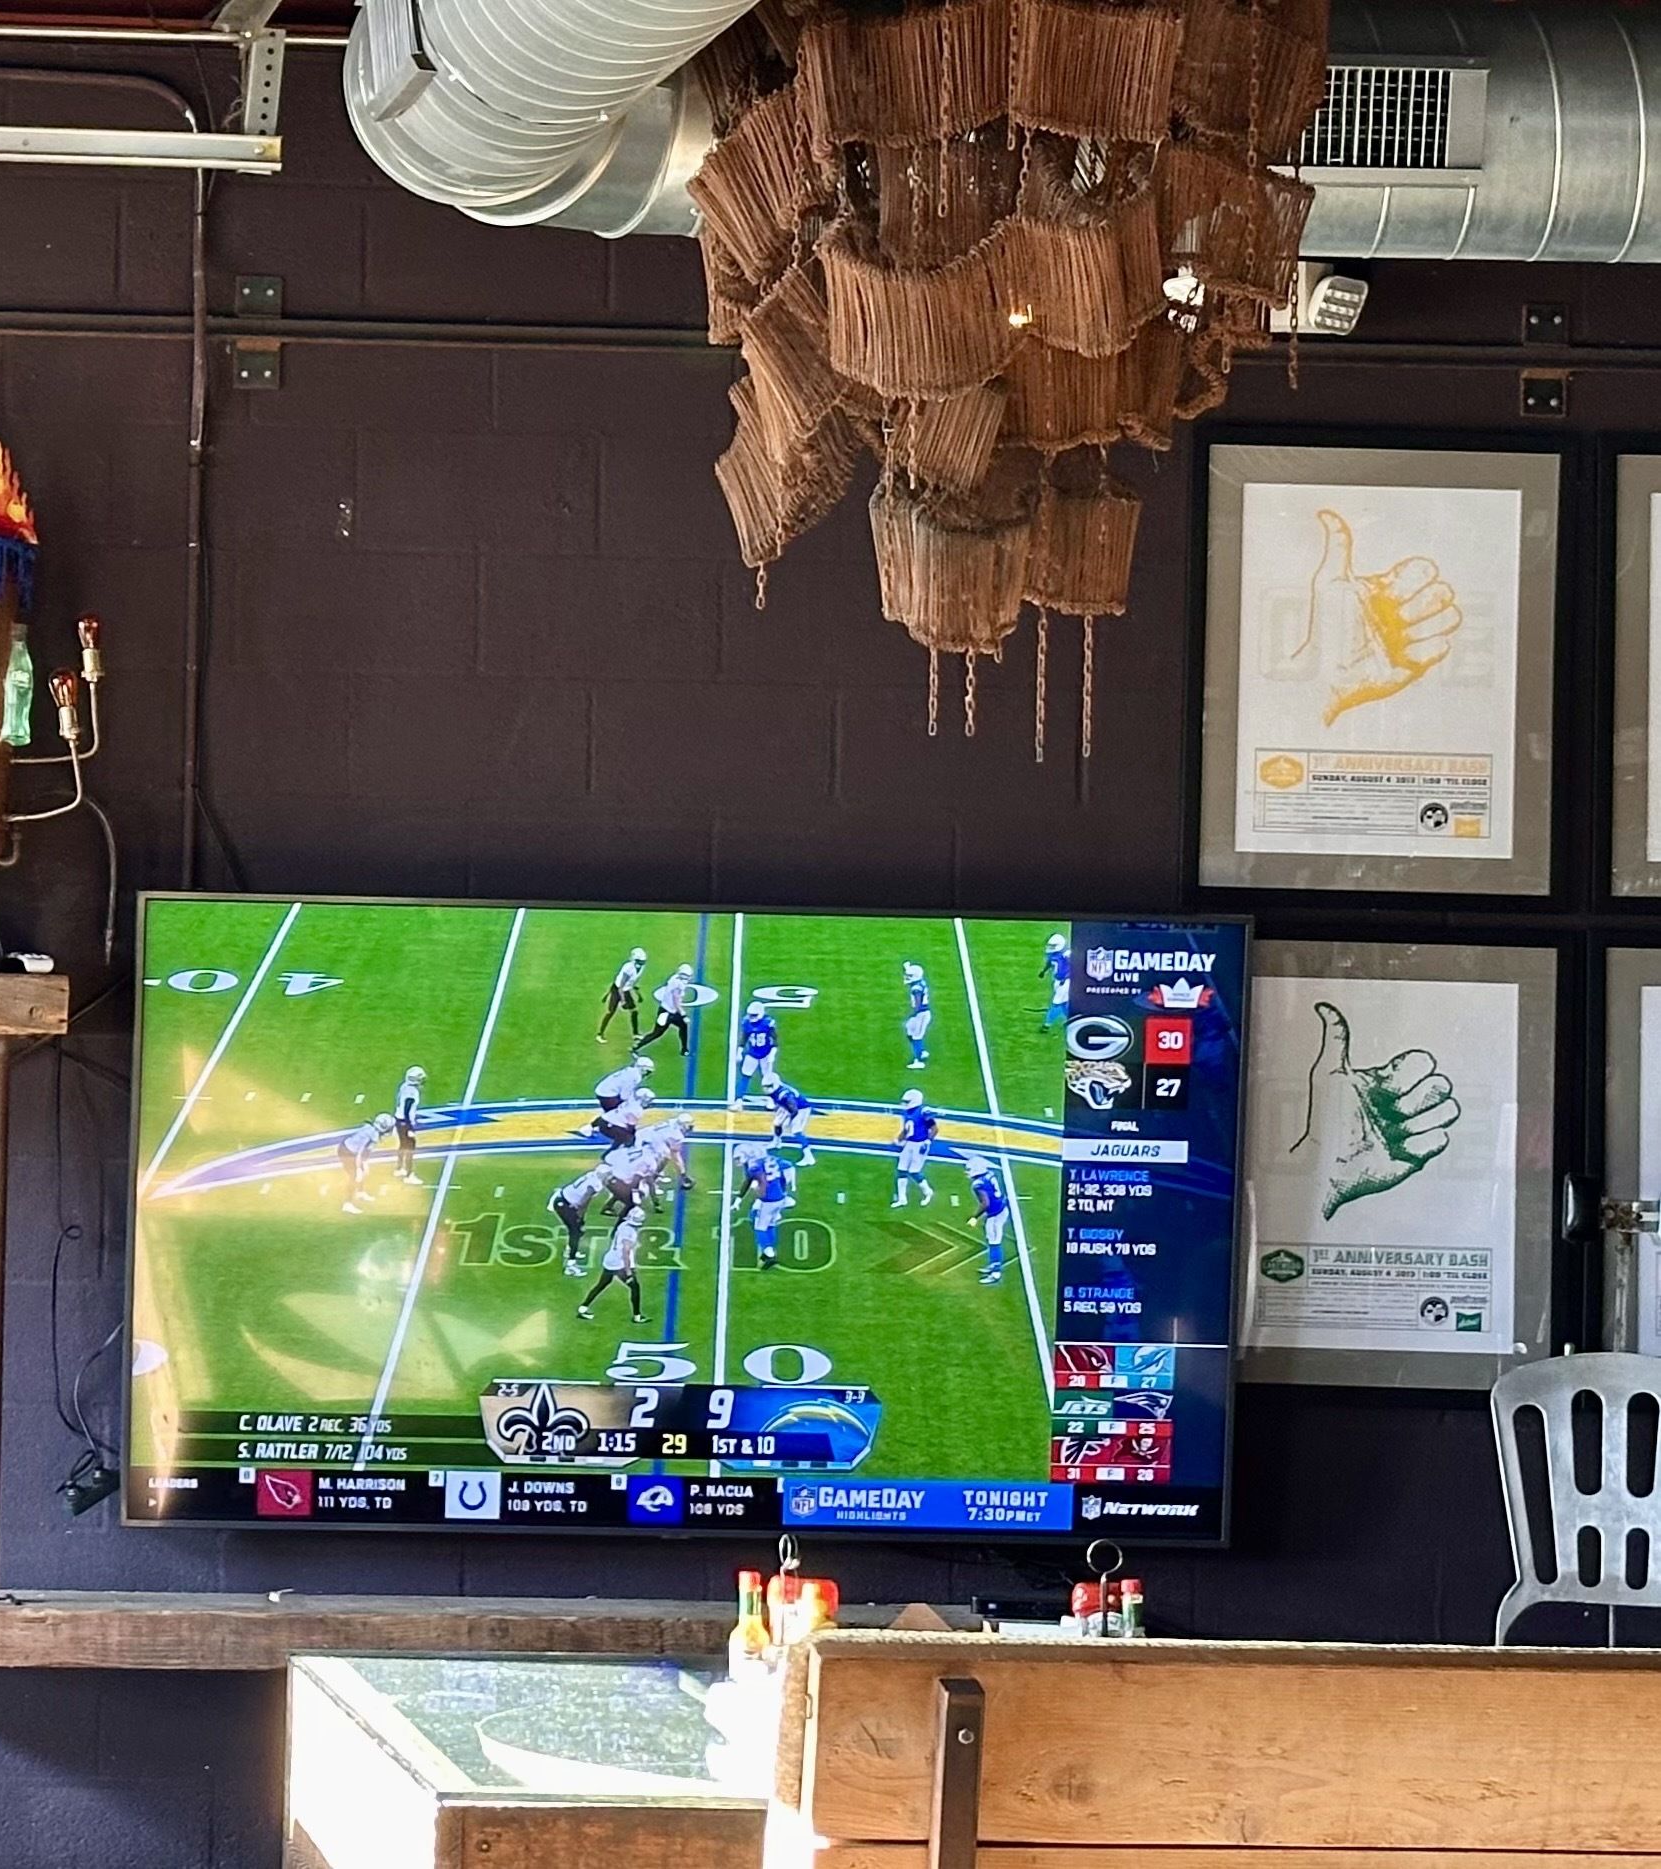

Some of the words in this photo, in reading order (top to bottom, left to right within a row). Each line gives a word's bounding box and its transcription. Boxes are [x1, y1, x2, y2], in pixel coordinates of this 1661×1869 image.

[1114, 972, 1139, 982] LIVE
[1158, 1031, 1183, 1049] 30
[1156, 1078, 1181, 1097] 27
[1111, 1121, 1139, 1132] FINAL
[1091, 1144, 1161, 1157] JAGUARS
[1069, 1169, 1080, 1181] T.
[1082, 1170, 1150, 1182] LAWRENCE
[1128, 1184, 1152, 1196] YDS
[1067, 1199, 1076, 1211] 2
[1097, 1200, 1114, 1211] INT
[1132, 1244, 1156, 1256] YDS
[1334, 1250, 1445, 1266] ANNIVERSARY
[1449, 1252, 1488, 1267] BASH
[1064, 1301, 1071, 1312] 5
[1118, 1302, 1141, 1313] YDS
[1141, 1376, 1156, 1388] 27
[630, 1388, 659, 1428] 2
[707, 1389, 735, 1429] 9
[239, 1415, 252, 1431] C.
[257, 1415, 303, 1432] OLAVE
[308, 1416, 319, 1432] 2
[348, 1417, 368, 1433] 36
[369, 1419, 392, 1433] YDS
[1067, 1421, 1084, 1434] 22
[542, 1432, 576, 1451] 2ND
[597, 1432, 636, 1451] 1:15
[662, 1433, 687, 1454] 29
[712, 1435, 737, 1454] 1ST
[741, 1438, 754, 1454] &
[757, 1436, 775, 1454] 10
[238, 1442, 250, 1458] S.
[255, 1443, 319, 1460] RATTLER
[385, 1448, 407, 1461] YDS
[1067, 1467, 1081, 1480] 31
[318, 1477, 333, 1490] M.
[337, 1478, 406, 1490] HARRISON
[508, 1481, 519, 1493] J.
[523, 1481, 575, 1494] DOWNS
[690, 1484, 703, 1497] P.
[706, 1485, 754, 1498] NACUA
[318, 1496, 334, 1508] 111
[375, 1497, 392, 1509] TD
[963, 1490, 1049, 1507] TONIGHT
[570, 1501, 587, 1512] TD
[717, 1503, 744, 1516] YDS
[1103, 1501, 1199, 1516] NETWORK
